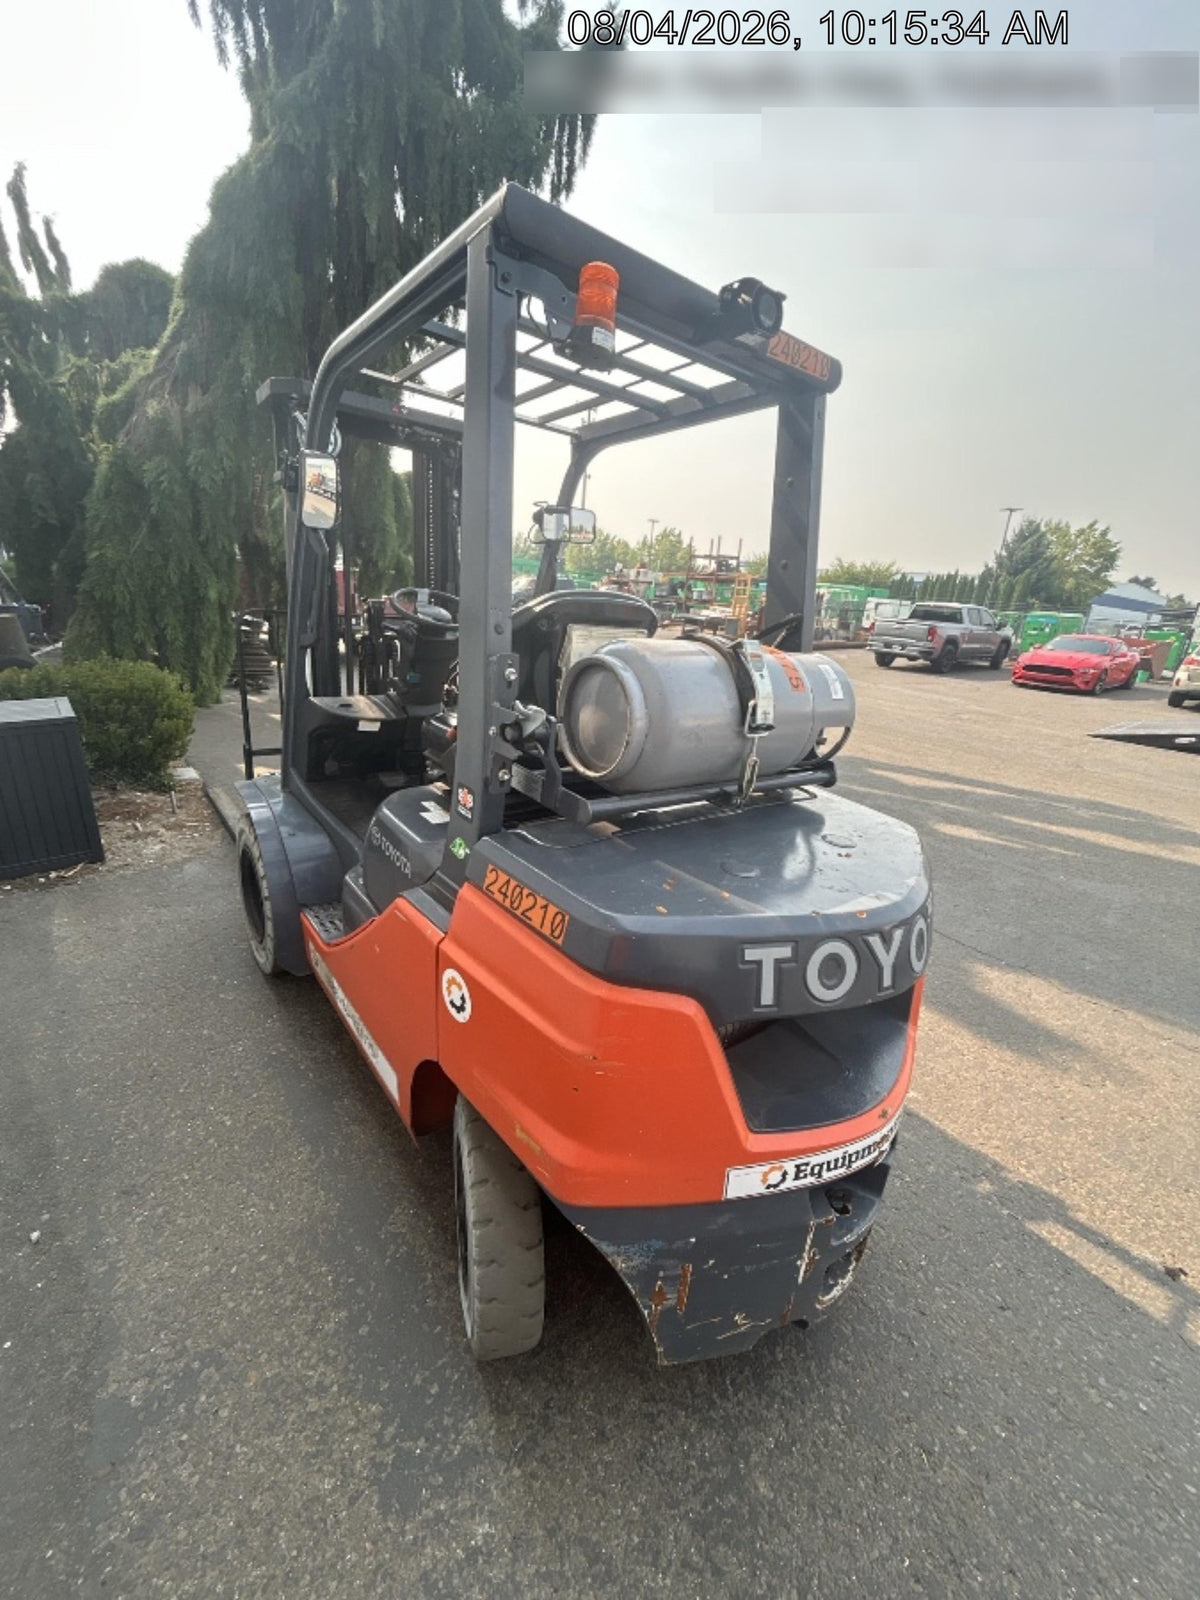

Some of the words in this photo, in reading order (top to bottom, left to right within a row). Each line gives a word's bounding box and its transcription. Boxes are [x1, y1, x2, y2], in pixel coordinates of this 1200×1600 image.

[768, 335, 829, 378] 240210
[381, 836, 411, 879] TOYOTA
[485, 868, 566, 940] 240210
[744, 915, 928, 1006] TOYO
[793, 1128, 892, 1181] Equipm
